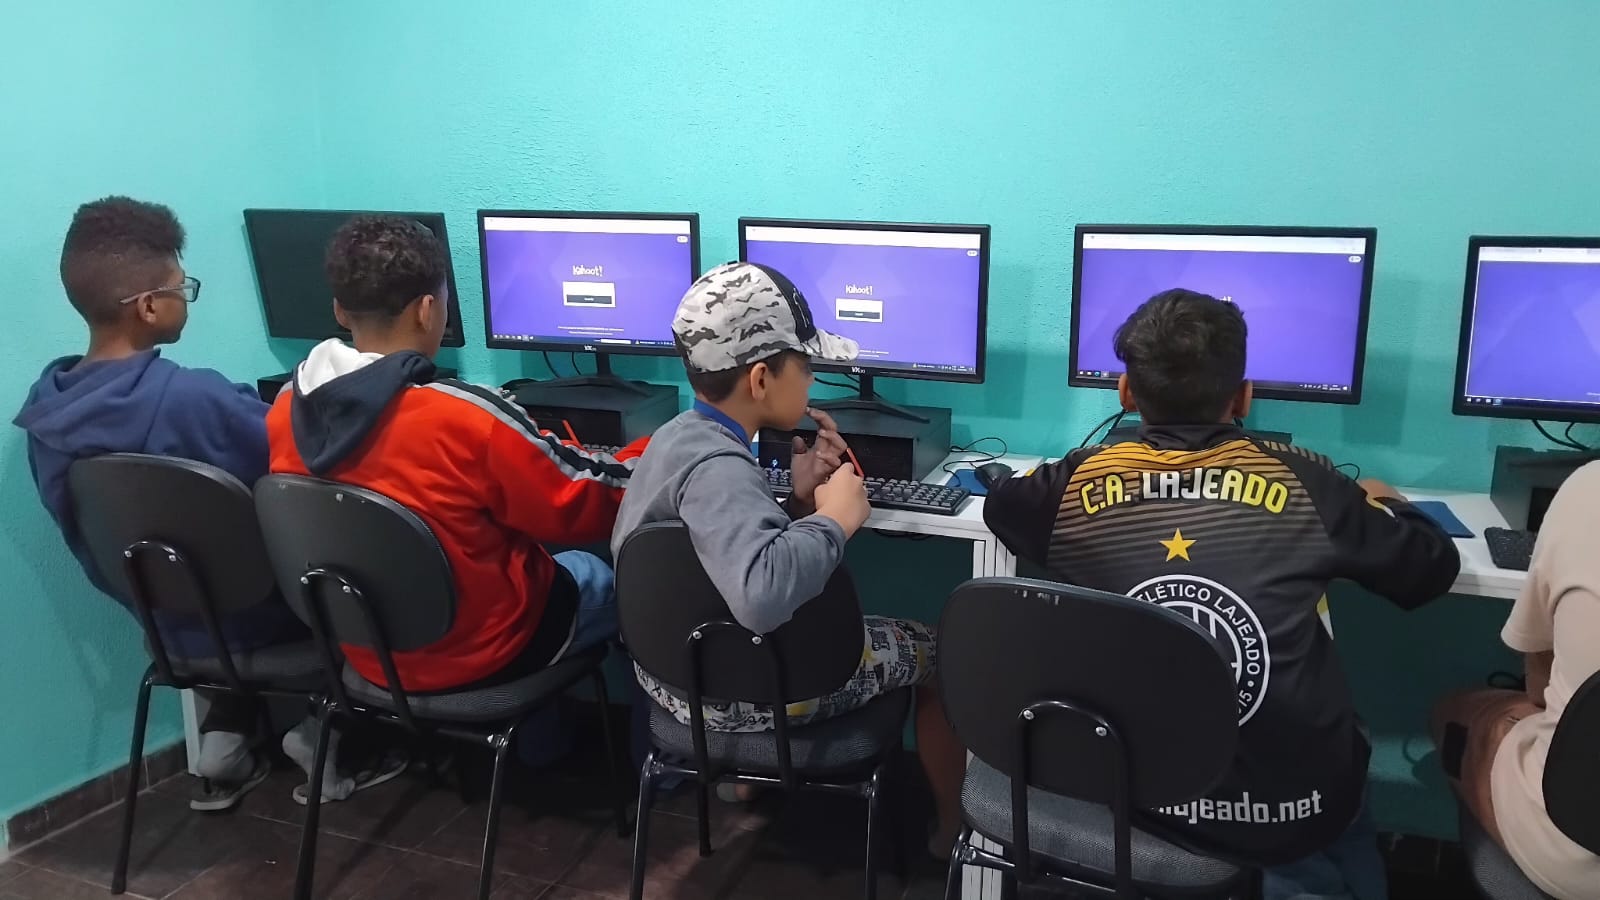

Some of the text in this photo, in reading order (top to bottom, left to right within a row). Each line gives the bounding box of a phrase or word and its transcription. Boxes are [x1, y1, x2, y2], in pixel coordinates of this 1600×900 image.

[572, 264, 603, 277] Kahoot!
[845, 284, 873, 295] Kahoot!
[1080, 467, 1289, 515] C.A. LAJEADO
[1213, 596, 1260, 675] LAJEADO
